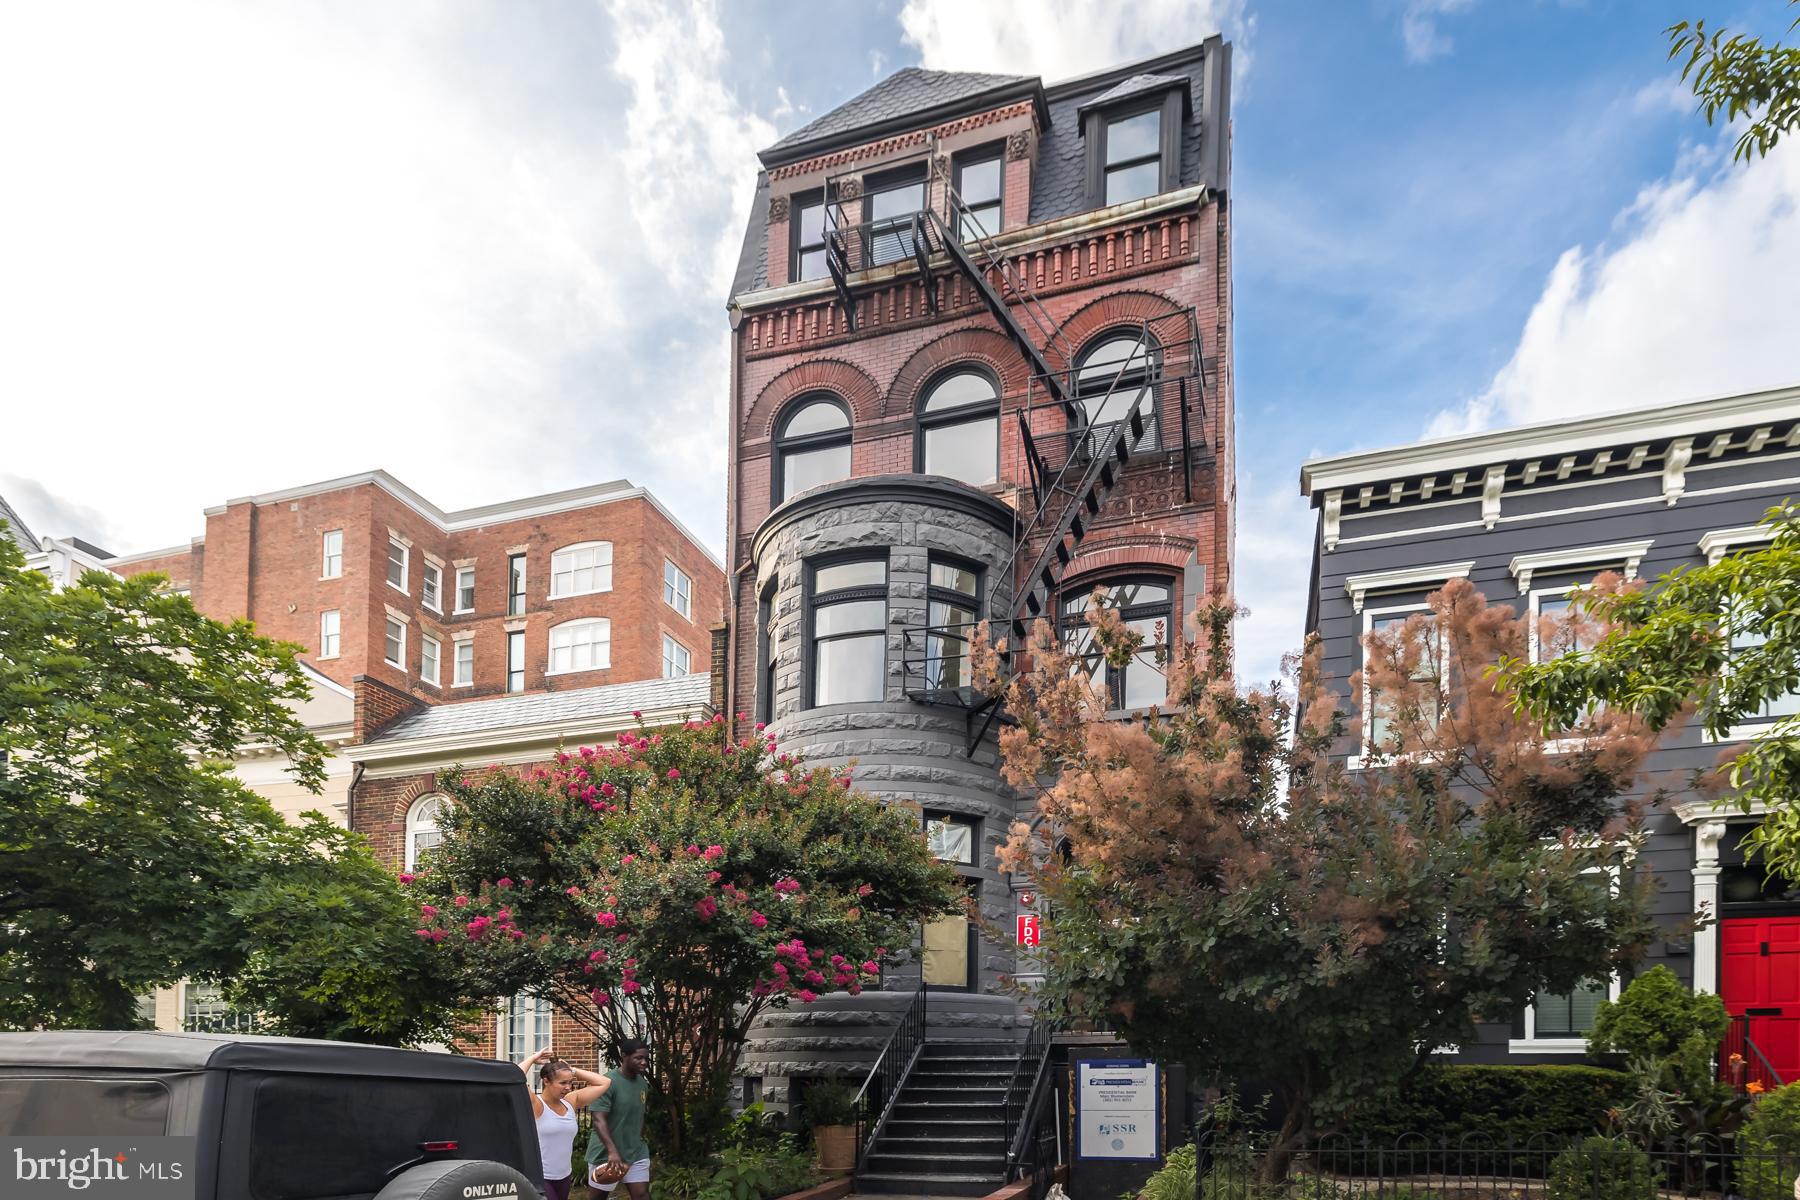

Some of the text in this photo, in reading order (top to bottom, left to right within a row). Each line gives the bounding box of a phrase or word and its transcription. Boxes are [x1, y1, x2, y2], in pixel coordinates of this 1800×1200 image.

[1024, 918, 1033, 948] FDC
[1113, 1124, 1136, 1132] SSR
[463, 1182, 517, 1198] ONLY IN A
